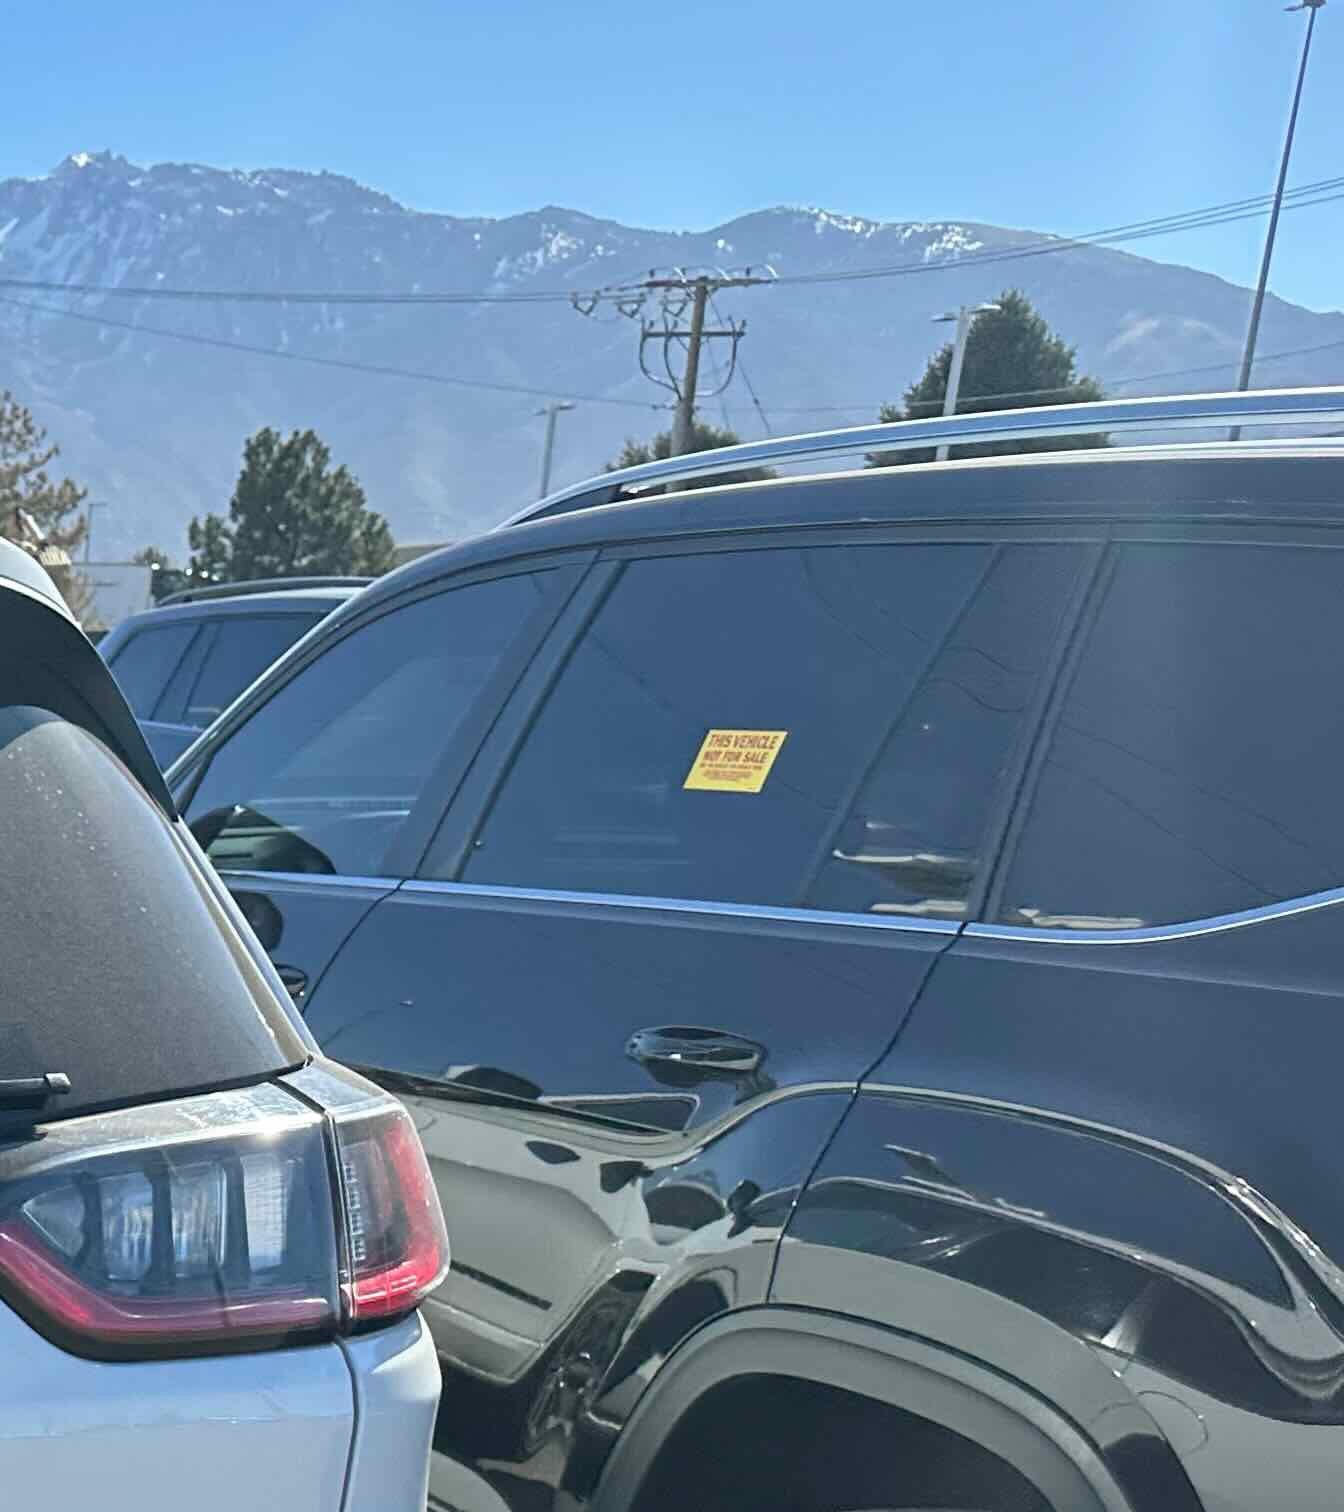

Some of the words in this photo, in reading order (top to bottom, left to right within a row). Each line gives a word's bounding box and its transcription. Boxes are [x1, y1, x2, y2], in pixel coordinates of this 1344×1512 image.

[707, 733, 732, 748] THIS
[733, 734, 780, 750] VEHICLE
[703, 751, 722, 762] NOT
[723, 751, 742, 763] FOR
[743, 751, 770, 764] SALE
